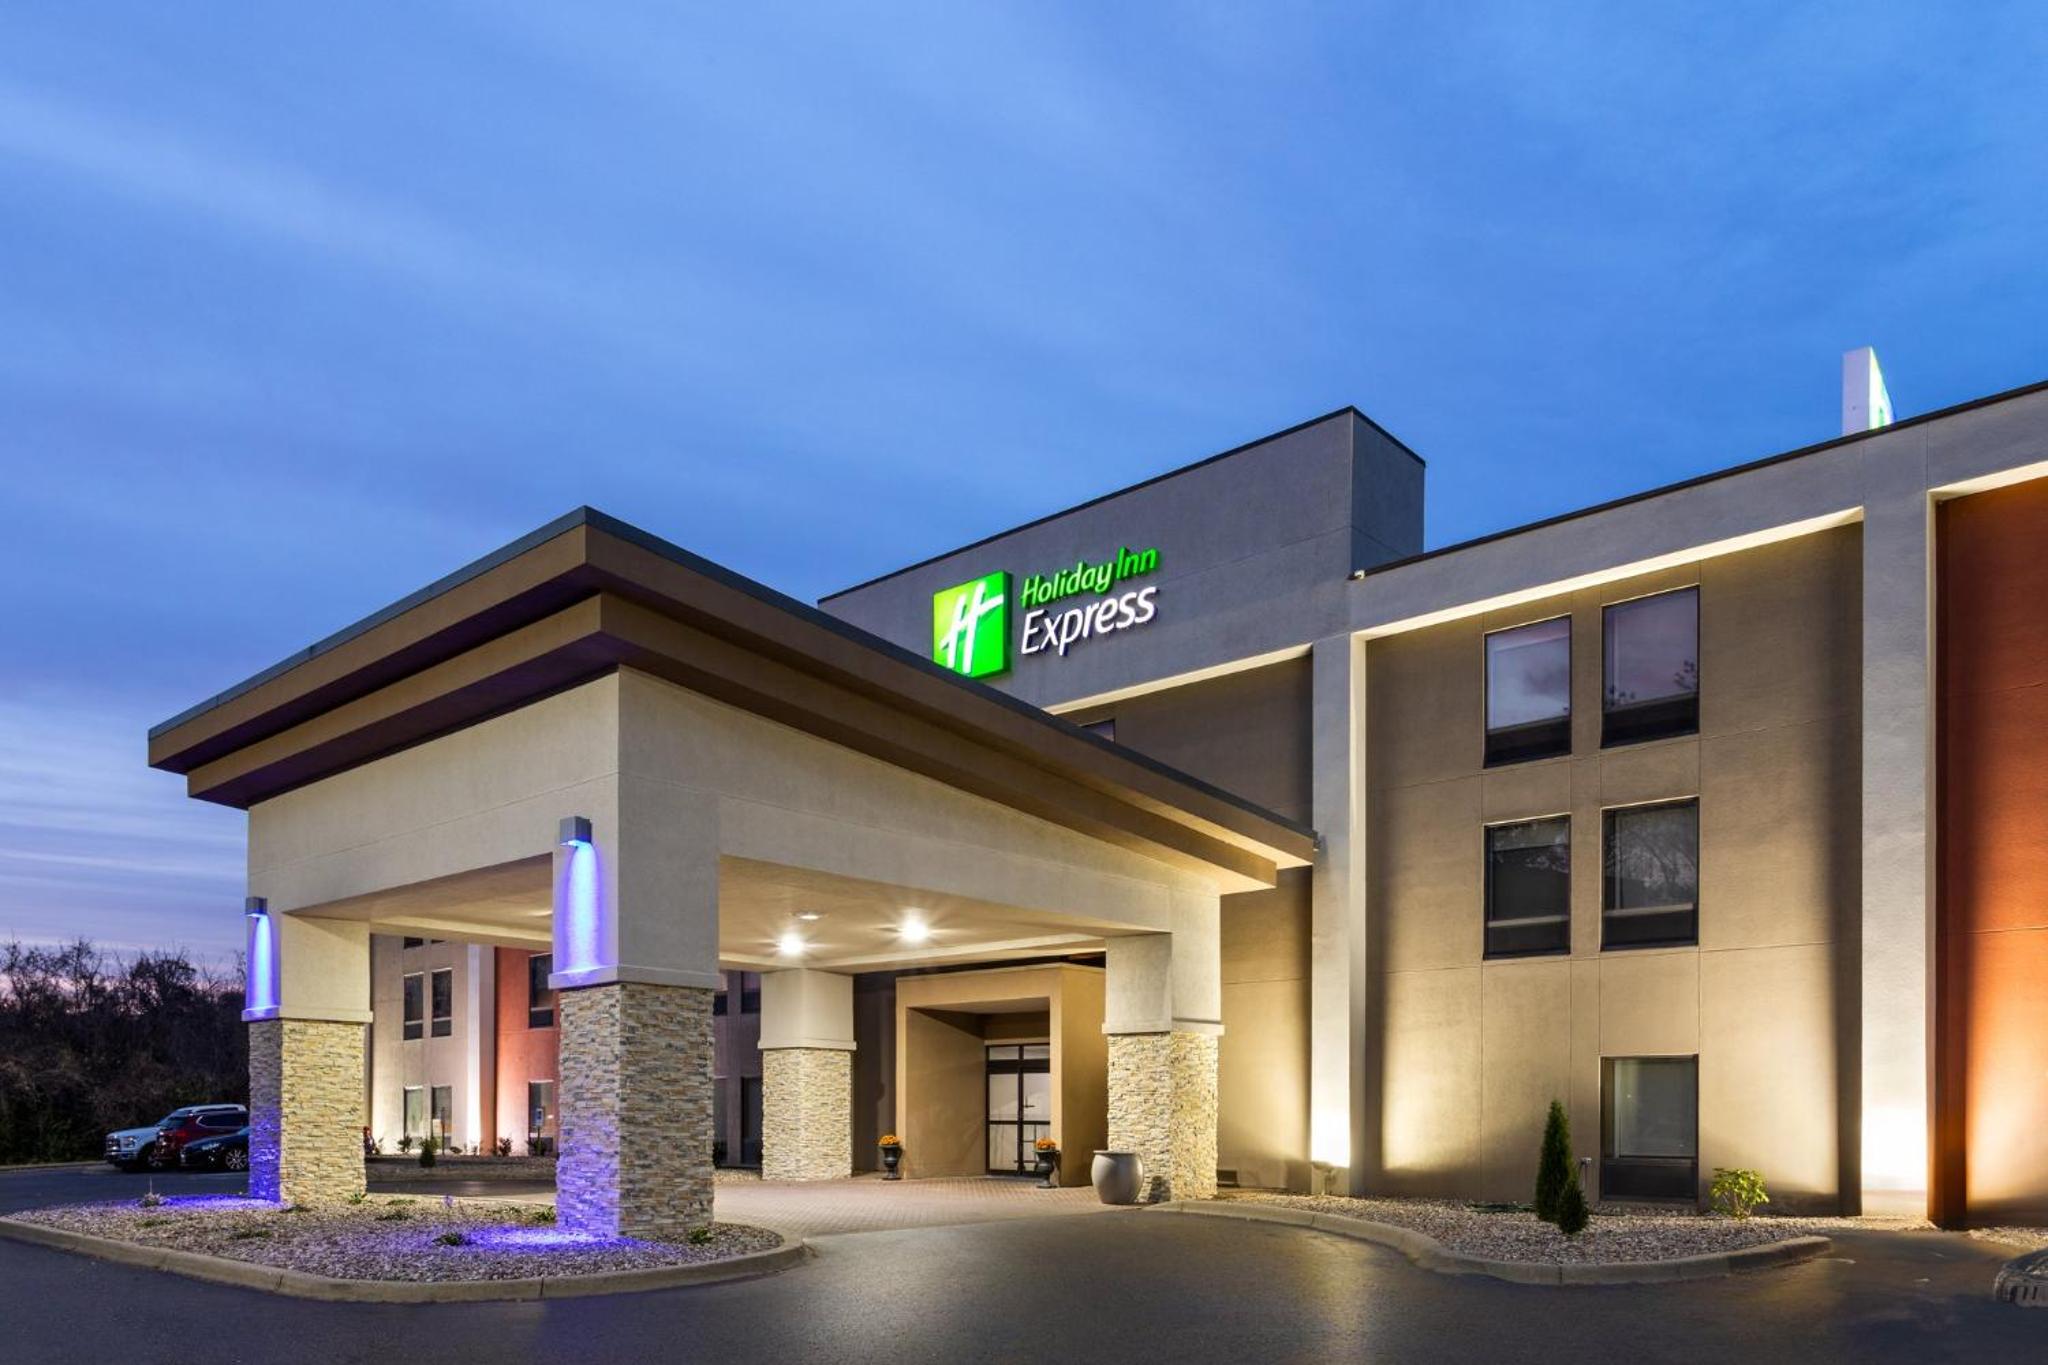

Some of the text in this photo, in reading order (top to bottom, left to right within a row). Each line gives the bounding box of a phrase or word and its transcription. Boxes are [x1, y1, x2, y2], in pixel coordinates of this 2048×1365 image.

[1020, 546, 1160, 608] Holiday Inn
[940, 581, 1004, 674] H
[1021, 586, 1157, 656] Express
